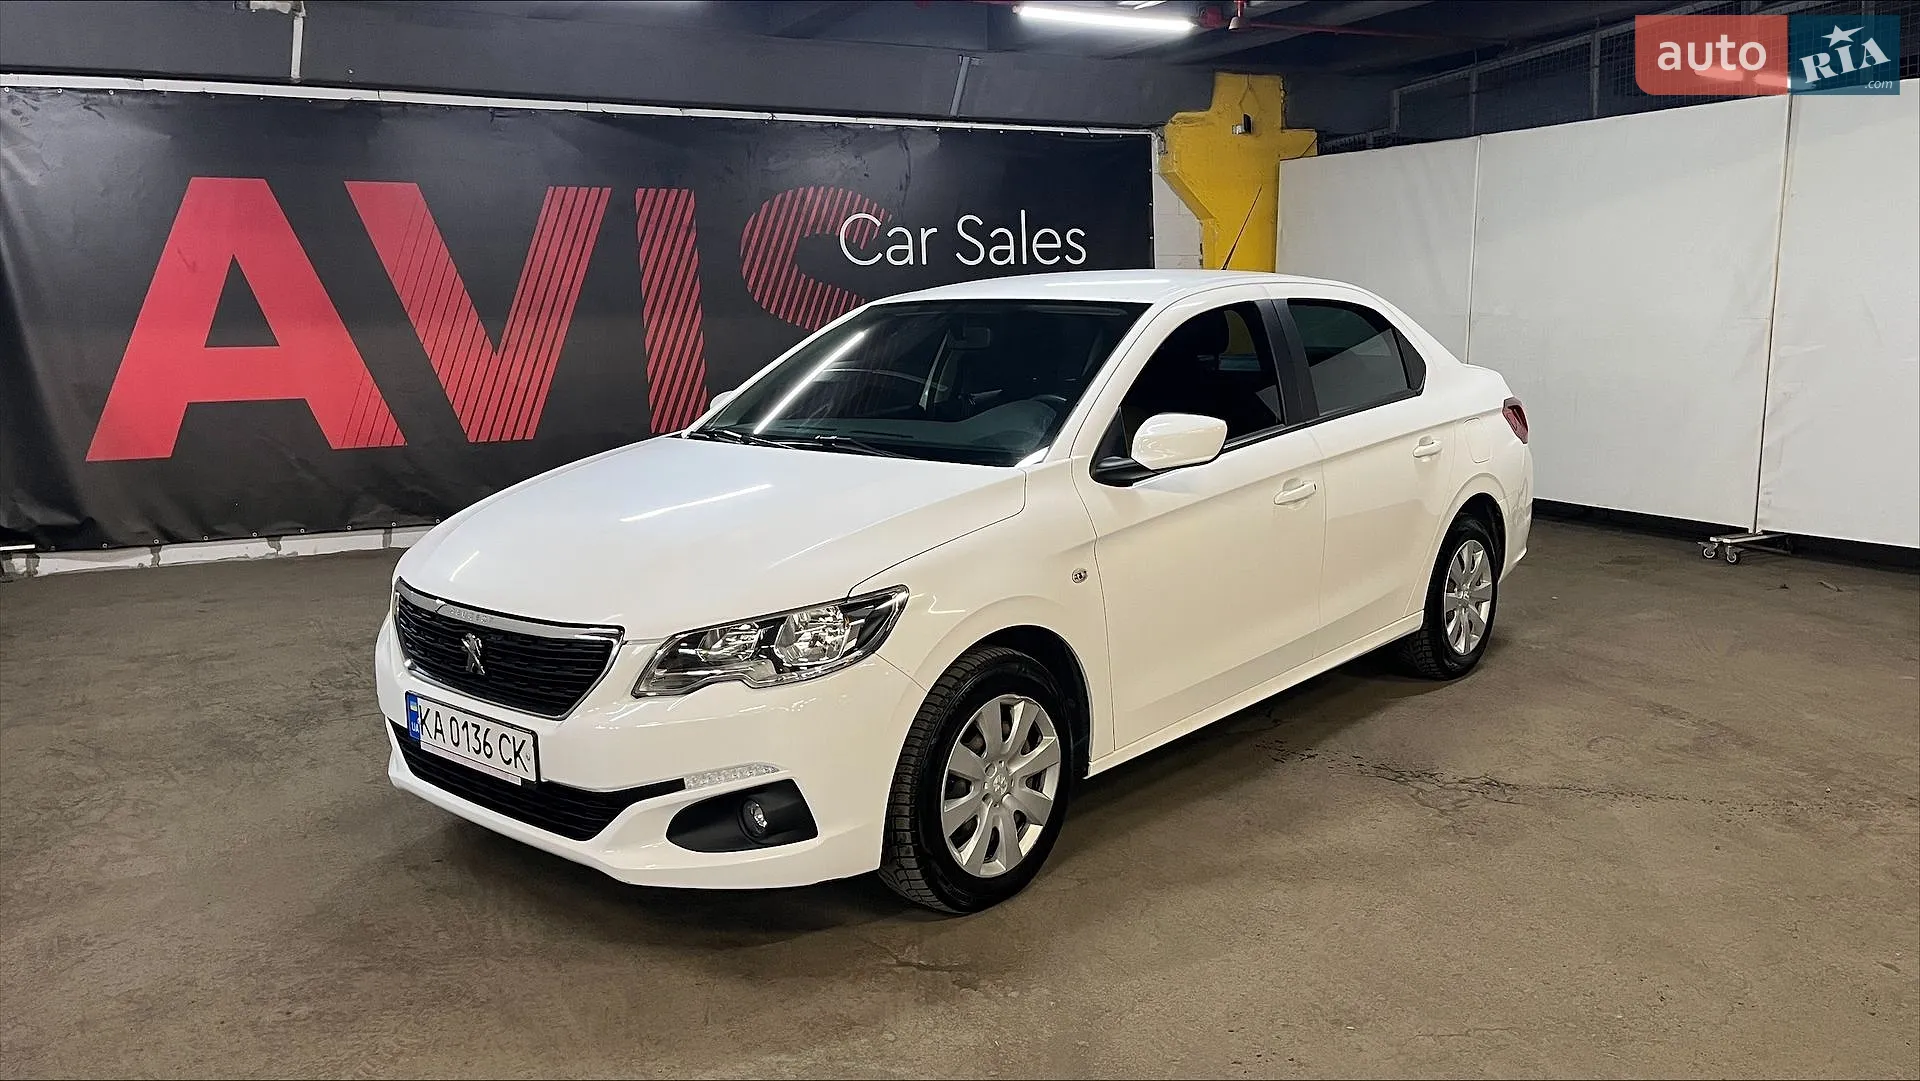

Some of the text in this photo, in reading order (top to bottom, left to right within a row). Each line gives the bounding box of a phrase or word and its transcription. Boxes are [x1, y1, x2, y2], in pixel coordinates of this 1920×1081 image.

[839, 209, 1087, 266] Car Sales
[86, 176, 892, 462] AVIS
[418, 704, 529, 773] KA 0136 CK
